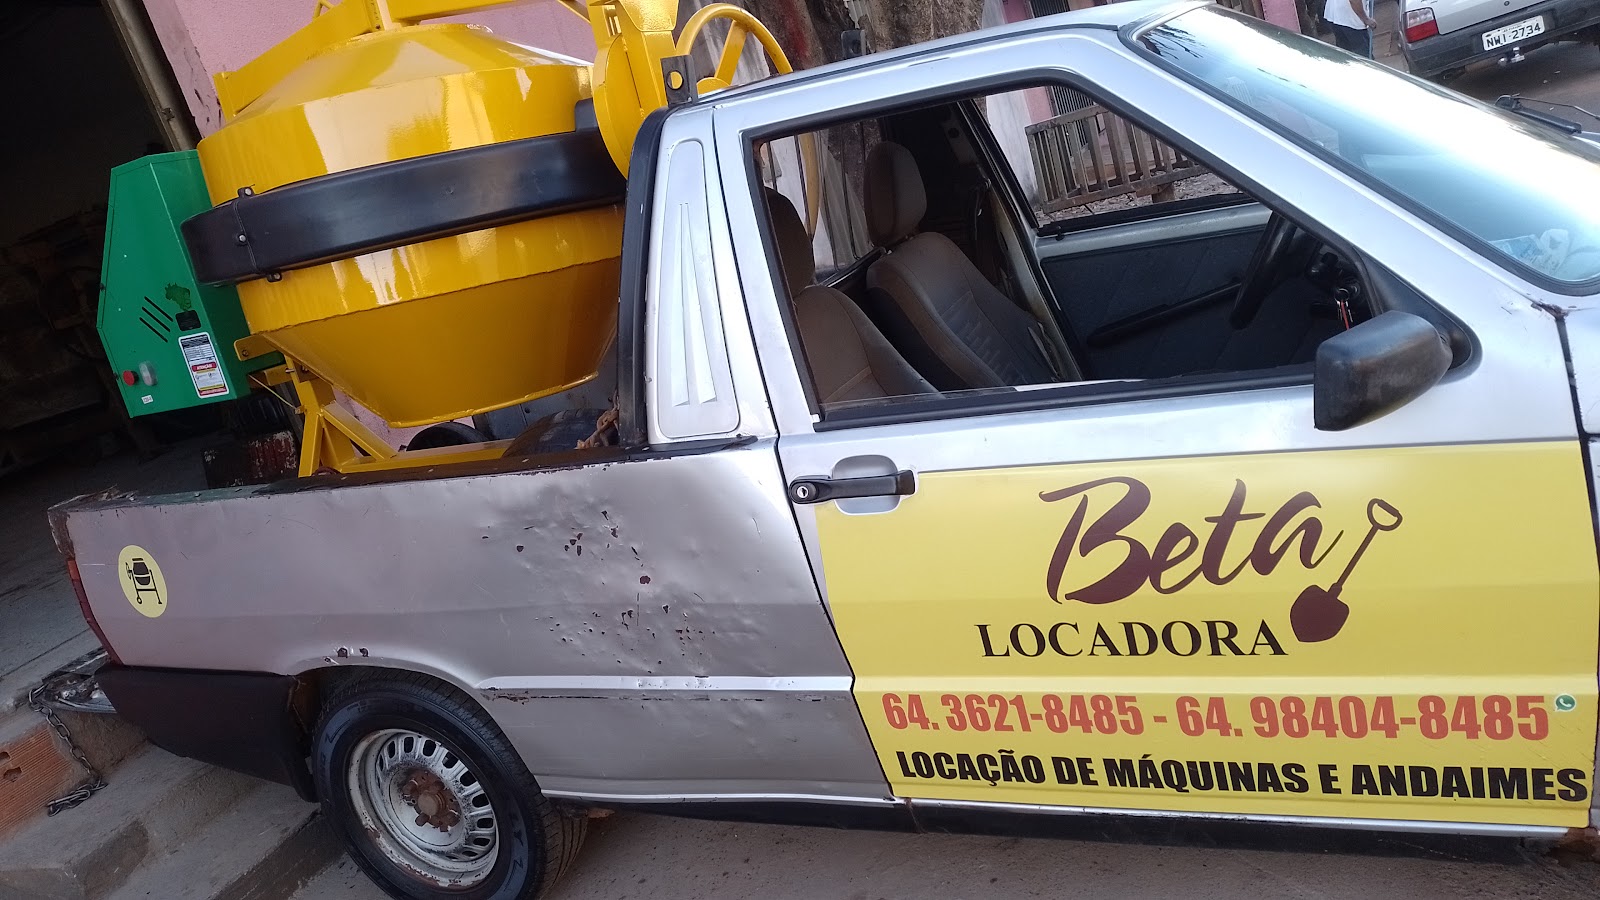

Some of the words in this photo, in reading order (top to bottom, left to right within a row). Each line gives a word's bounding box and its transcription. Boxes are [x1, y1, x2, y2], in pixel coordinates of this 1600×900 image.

[1039, 476, 1343, 604] Beta
[975, 620, 1288, 657] LOCADORA
[881, 692, 940, 731] 64.
[941, 693, 1145, 736] 3621-8485
[1175, 695, 1243, 737] 64.
[1249, 694, 1549, 741] 98404-8485
[895, 748, 1046, 787] LOCAÇÃO
[1050, 756, 1099, 787] DE
[1102, 753, 1310, 794] MÁQUINAS
[1317, 763, 1343, 795] E
[1351, 764, 1588, 803] ANDAIMES
